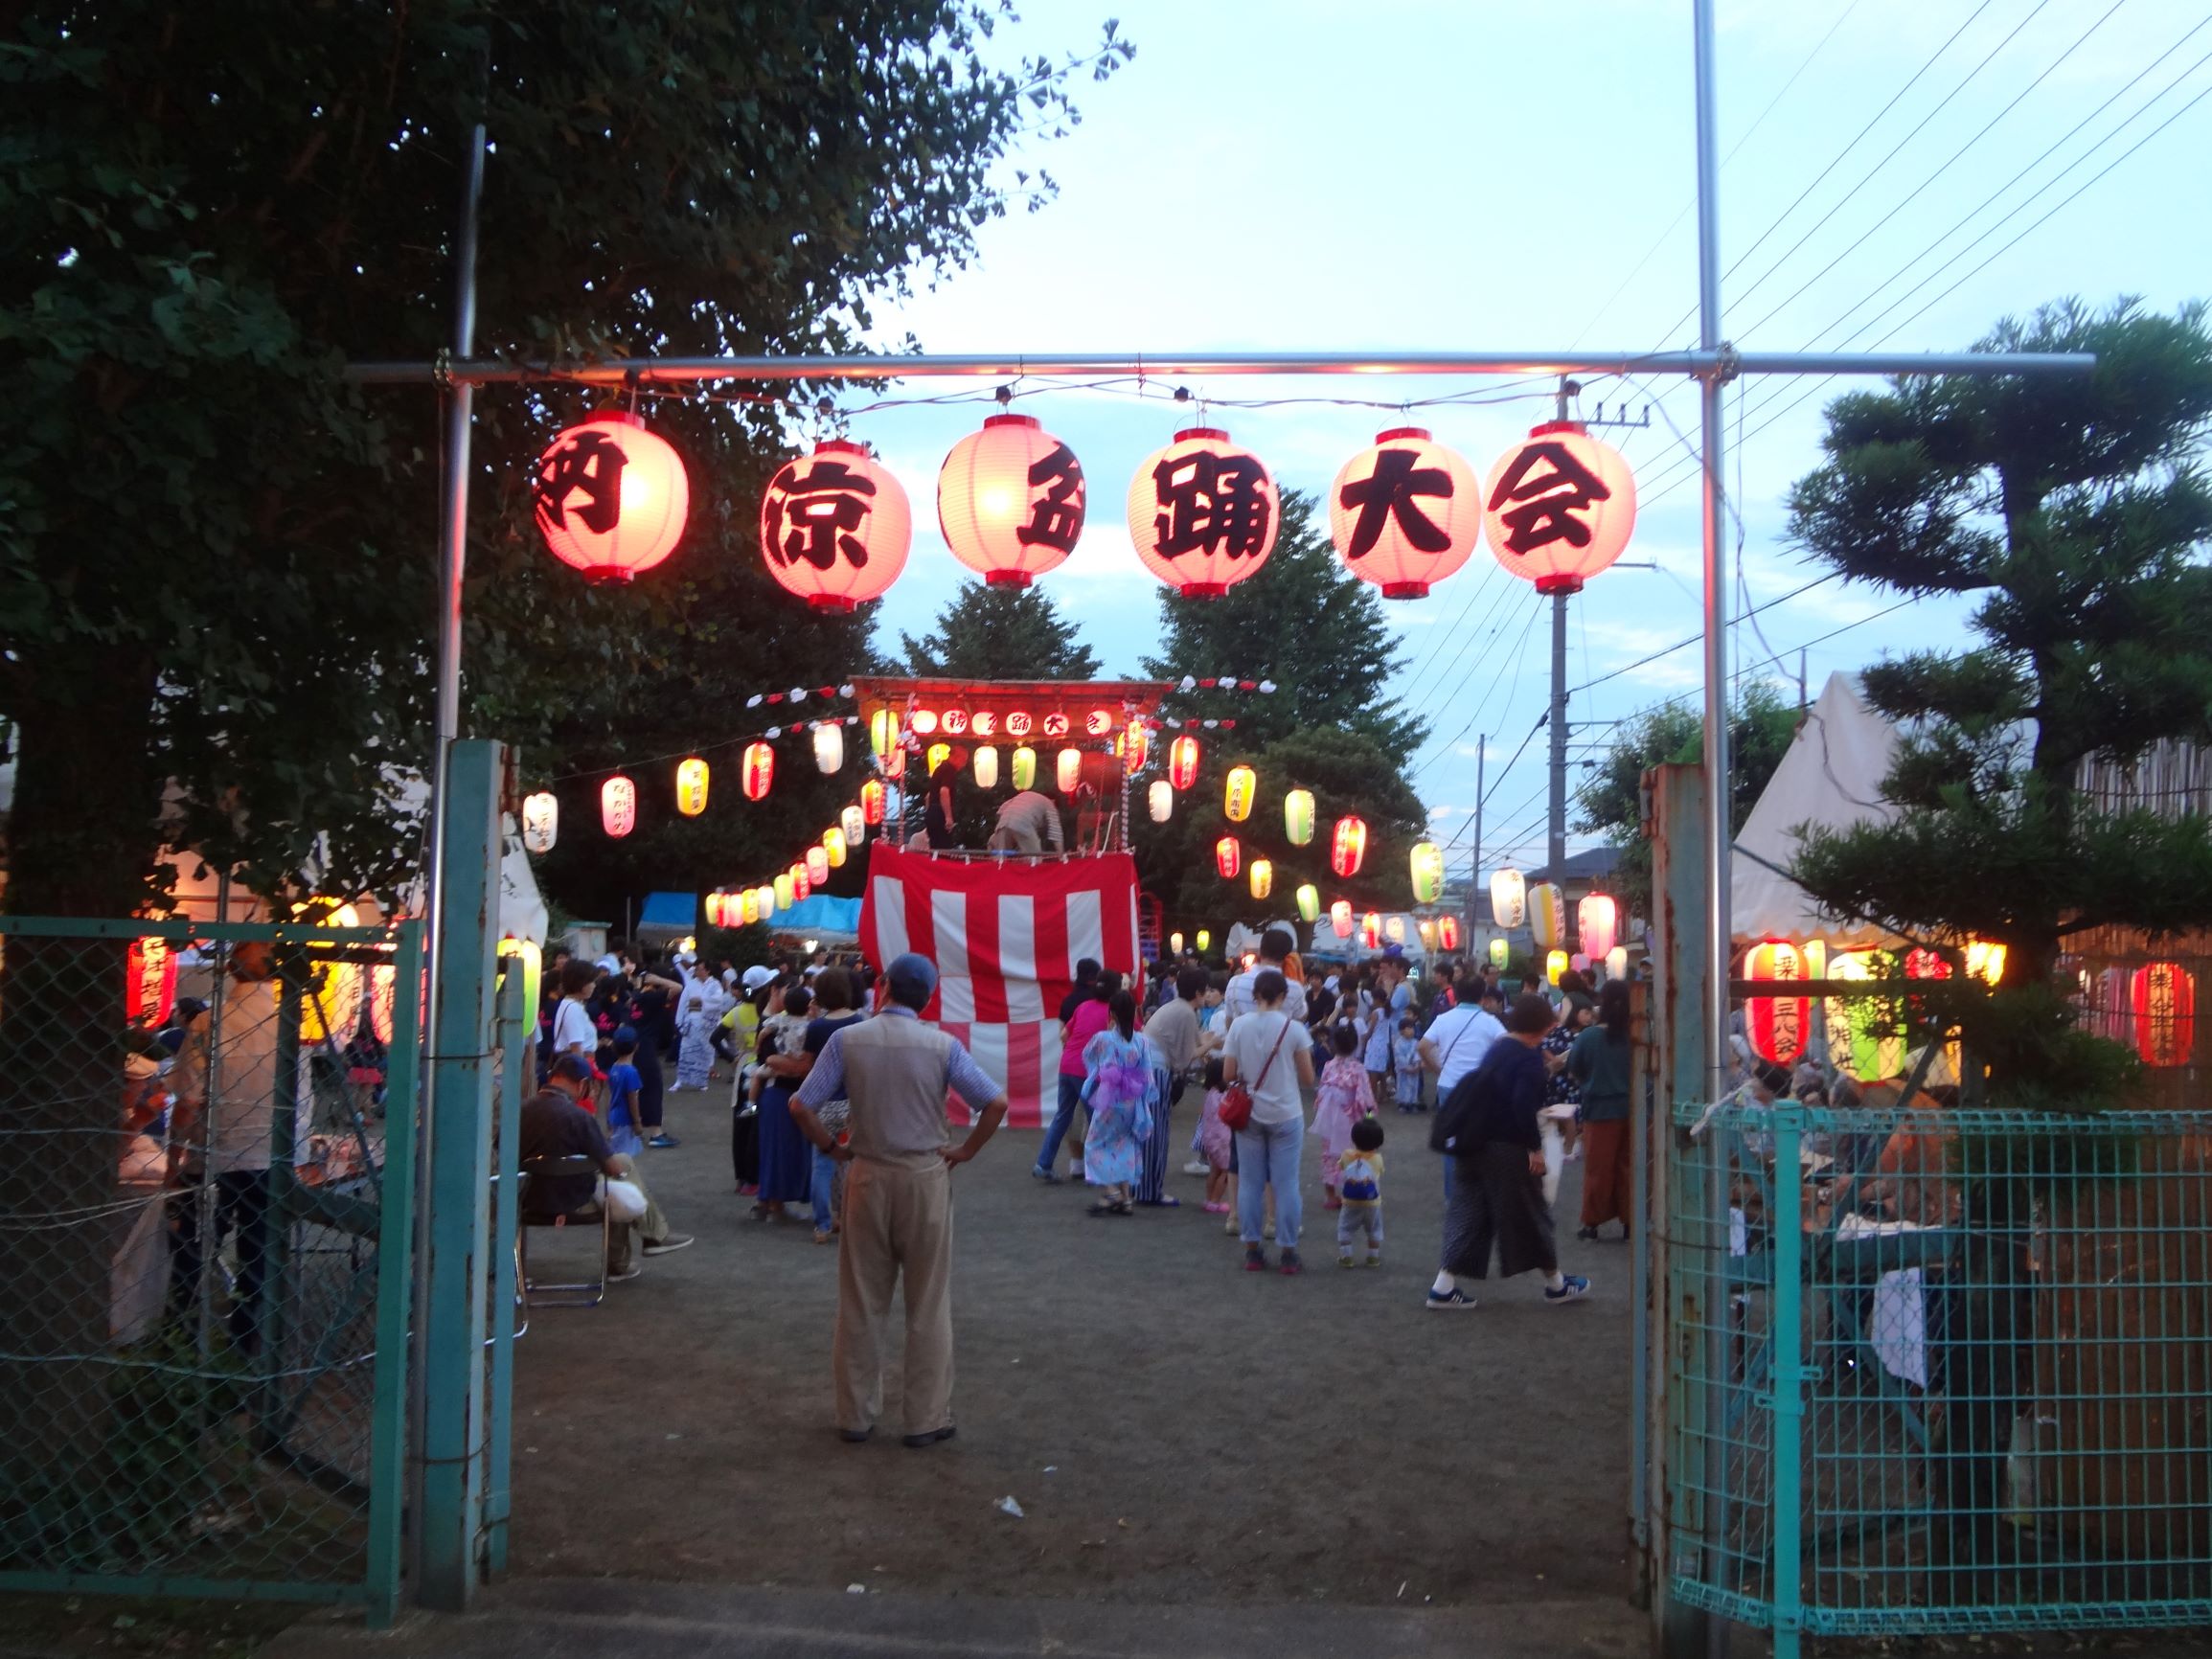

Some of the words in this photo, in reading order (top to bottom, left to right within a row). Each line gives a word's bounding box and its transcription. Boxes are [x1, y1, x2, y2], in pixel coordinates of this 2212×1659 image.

[764, 461, 878, 569] 涼
[1152, 450, 1272, 560] 踊
[1341, 449, 1454, 558] 大
[1488, 443, 1610, 555] 会
